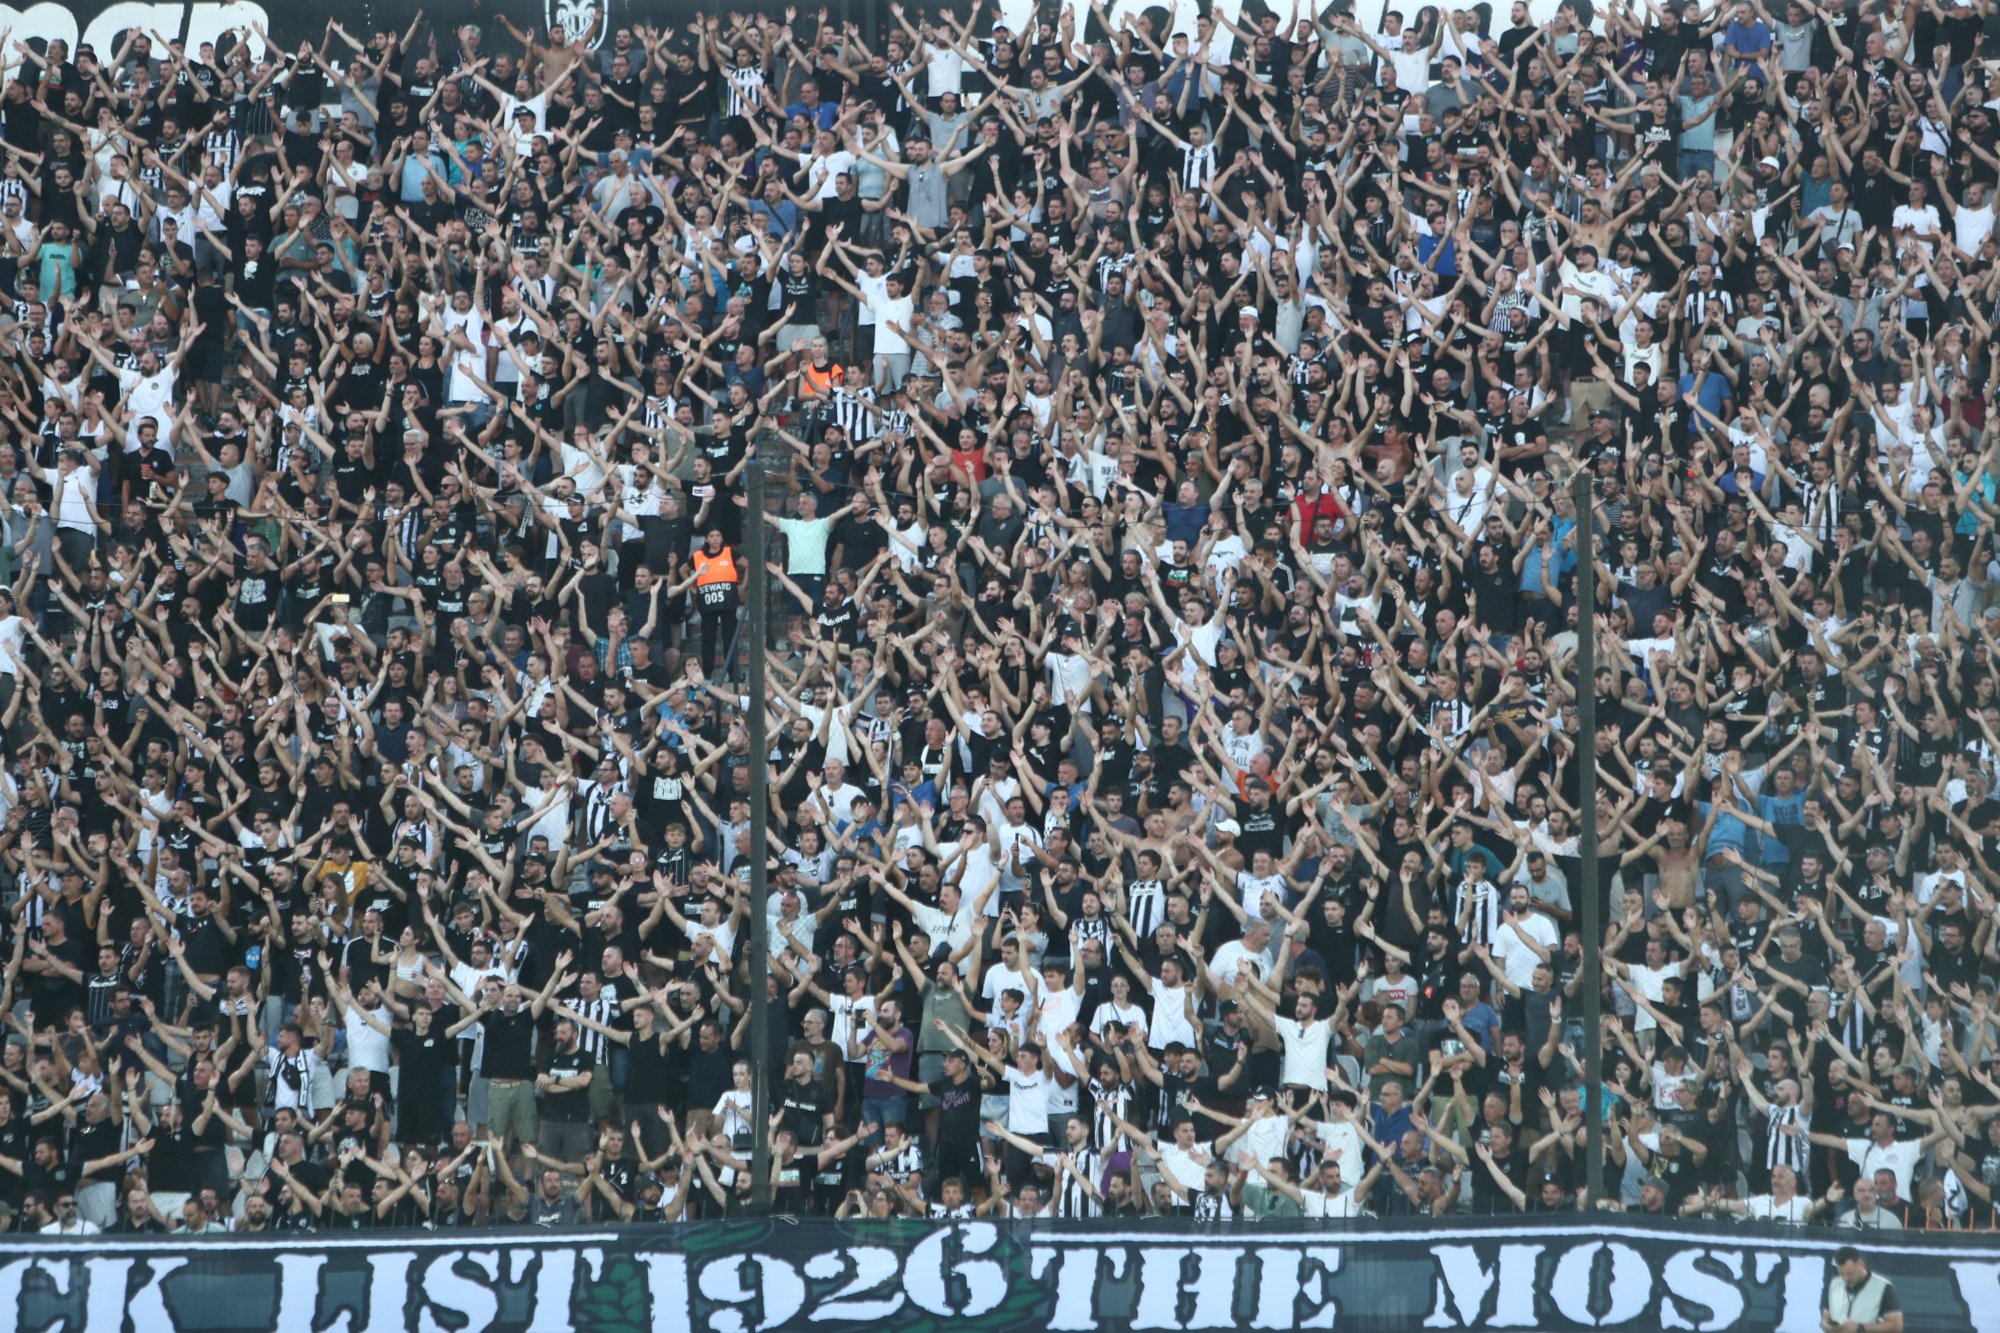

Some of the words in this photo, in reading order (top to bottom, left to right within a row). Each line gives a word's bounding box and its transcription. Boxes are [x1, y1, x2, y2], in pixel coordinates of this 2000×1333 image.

[699, 582, 732, 594] STEWARD
[704, 590, 725, 605] 005
[635, 1222, 1009, 1333] 1926
[1030, 1246, 1340, 1332] THE
